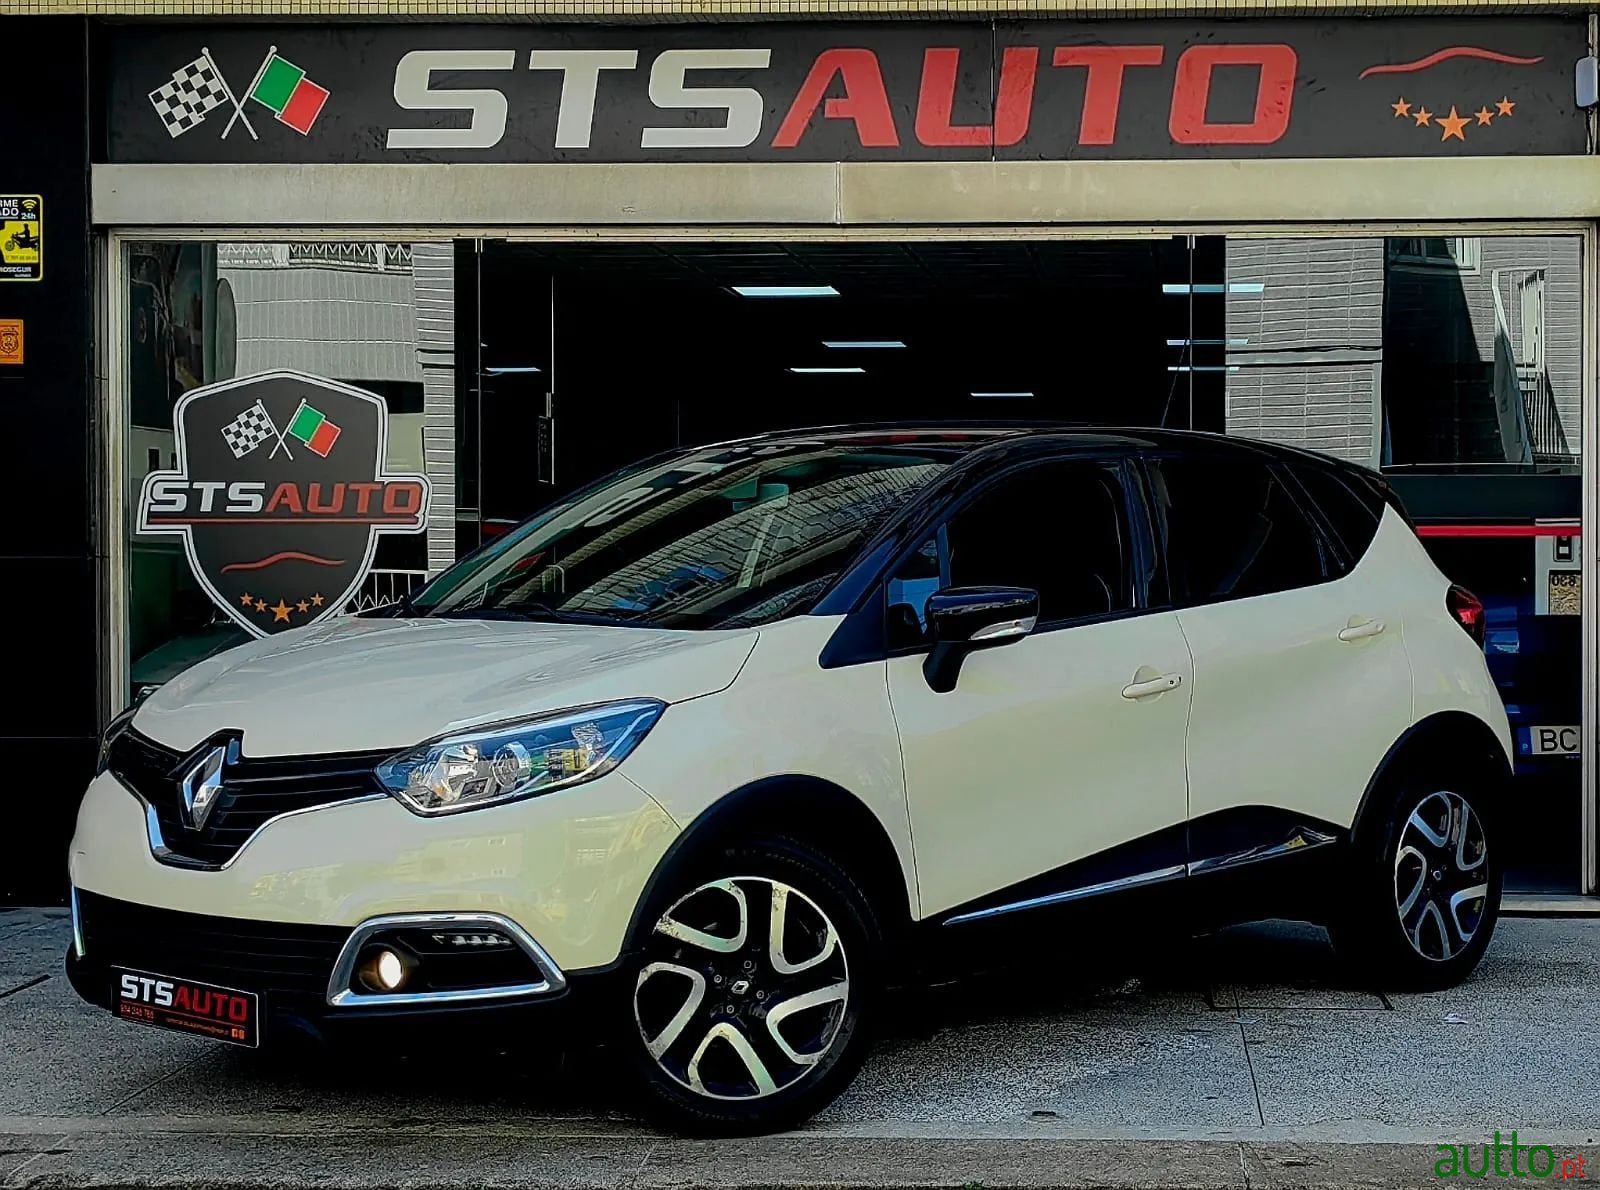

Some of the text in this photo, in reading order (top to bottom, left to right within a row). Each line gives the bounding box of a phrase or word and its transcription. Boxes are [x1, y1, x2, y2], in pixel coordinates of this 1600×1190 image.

[150, 482, 422, 513] STSAUTO
[1540, 728, 1577, 751] BC
[121, 974, 248, 1021] STSAUTO
